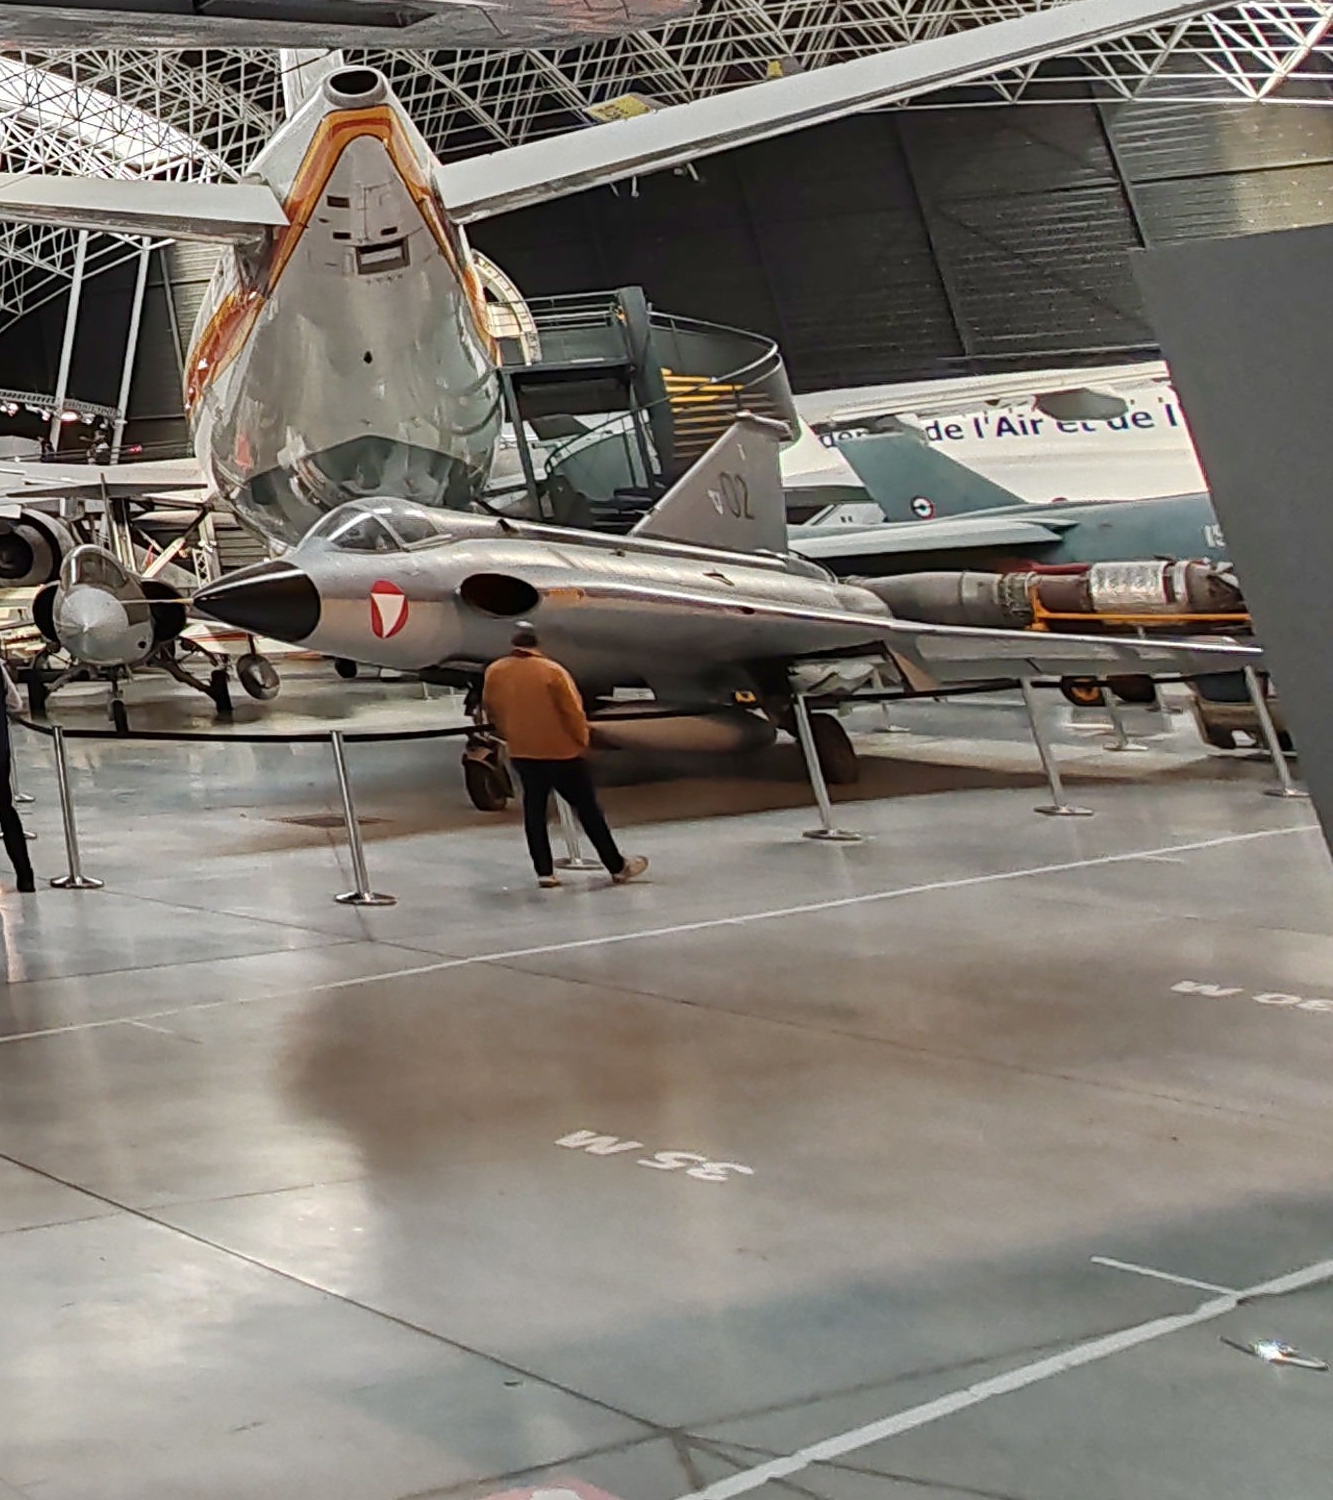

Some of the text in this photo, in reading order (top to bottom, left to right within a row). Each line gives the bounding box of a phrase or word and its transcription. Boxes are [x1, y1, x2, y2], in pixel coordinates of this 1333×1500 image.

[925, 420, 965, 441] de
[719, 471, 755, 520] 02
[554, 1129, 754, 1182] 35 M
